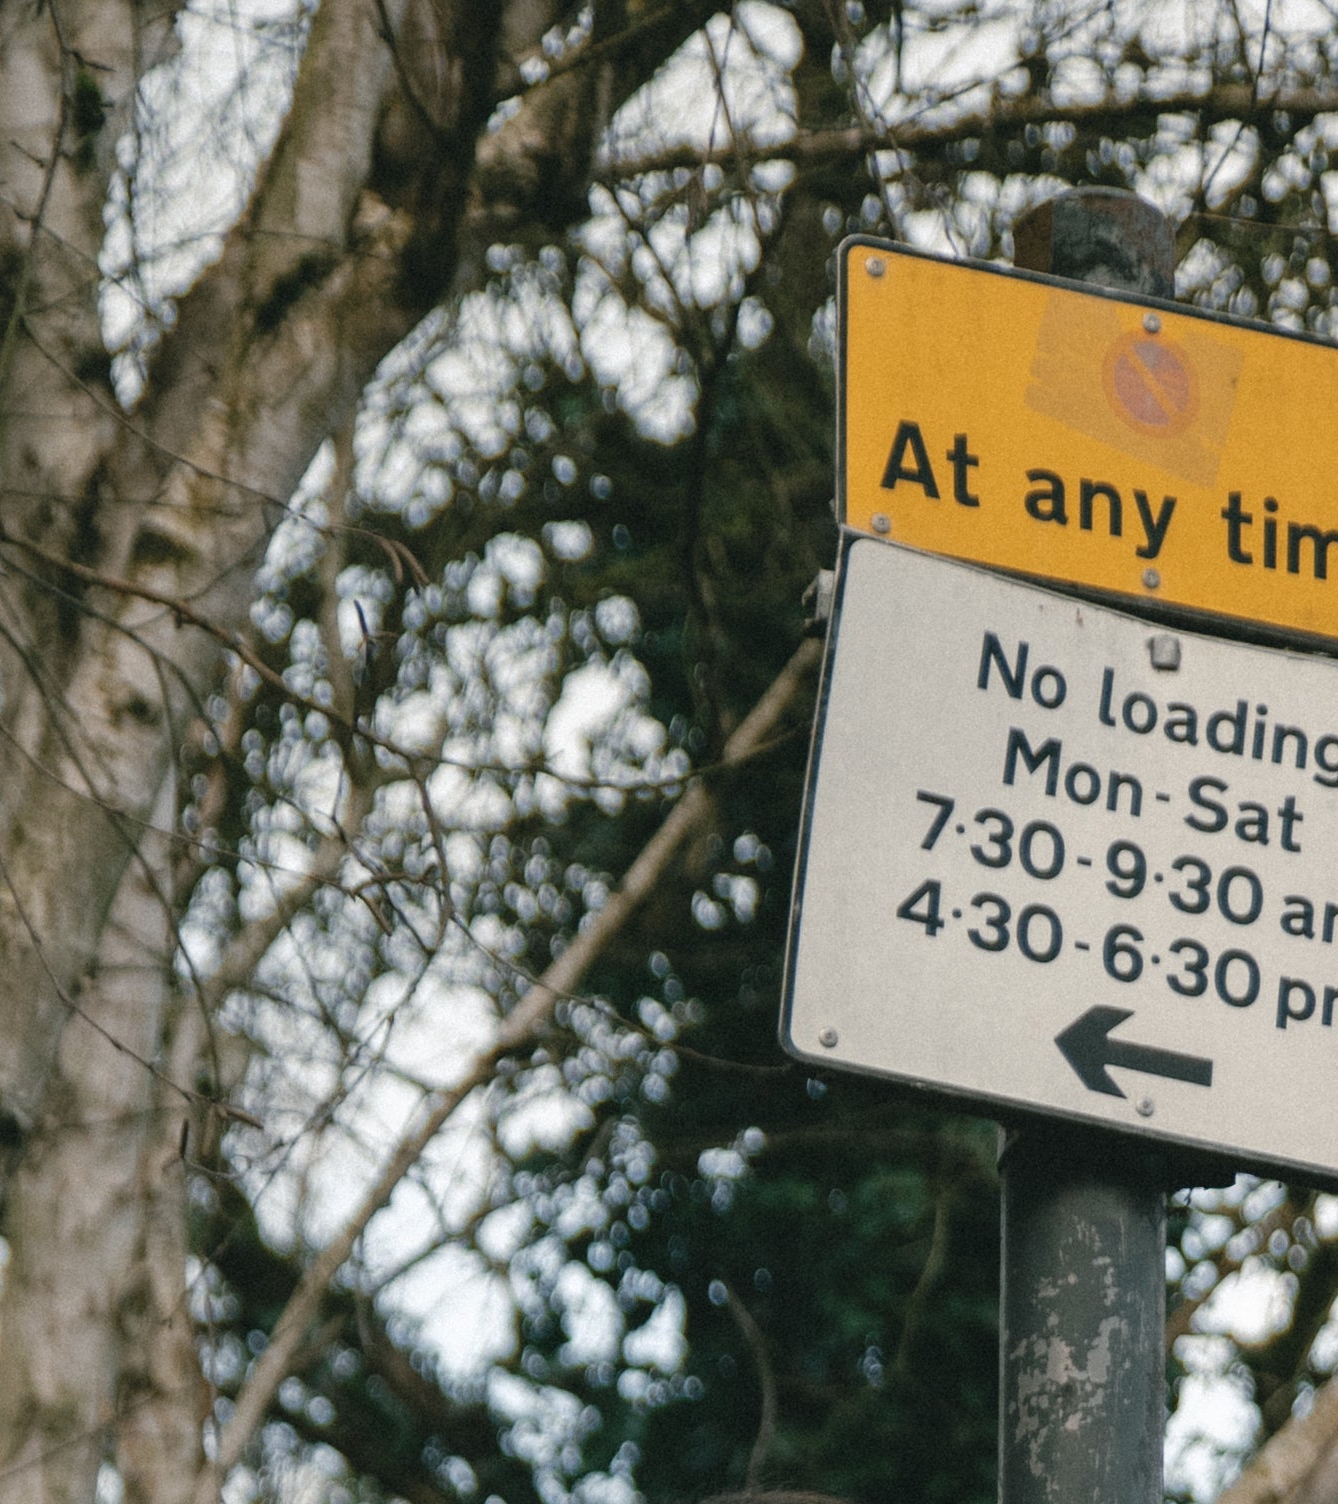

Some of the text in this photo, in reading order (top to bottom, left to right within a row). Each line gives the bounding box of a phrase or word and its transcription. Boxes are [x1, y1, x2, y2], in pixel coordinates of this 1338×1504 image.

[879, 420, 981, 509] At
[1023, 468, 1178, 561] any
[976, 631, 1068, 711] No
